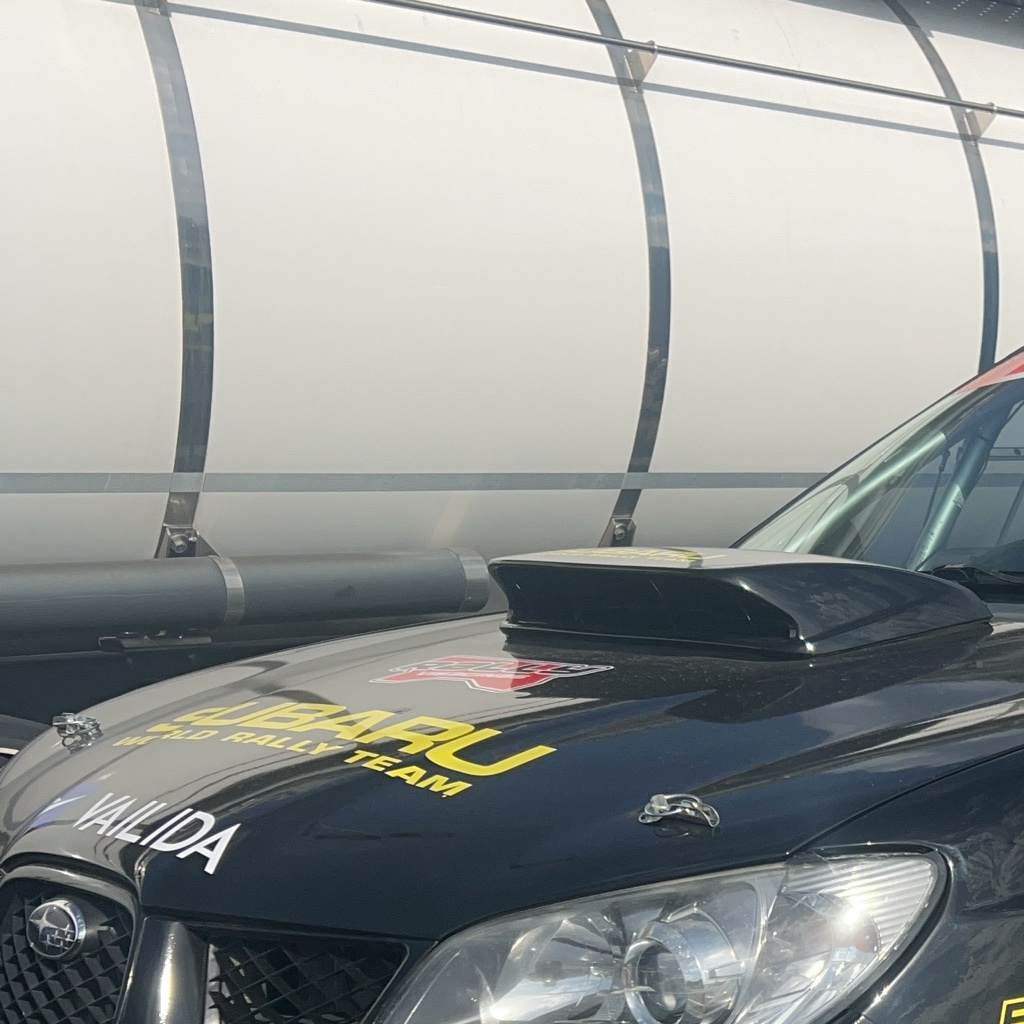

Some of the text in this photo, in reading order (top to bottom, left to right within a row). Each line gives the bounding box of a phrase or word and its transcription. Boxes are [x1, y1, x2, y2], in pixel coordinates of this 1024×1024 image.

[220, 731, 345, 756] RALLY
[343, 749, 473, 797] TEAM
[72, 792, 242, 875] VAILIDA
